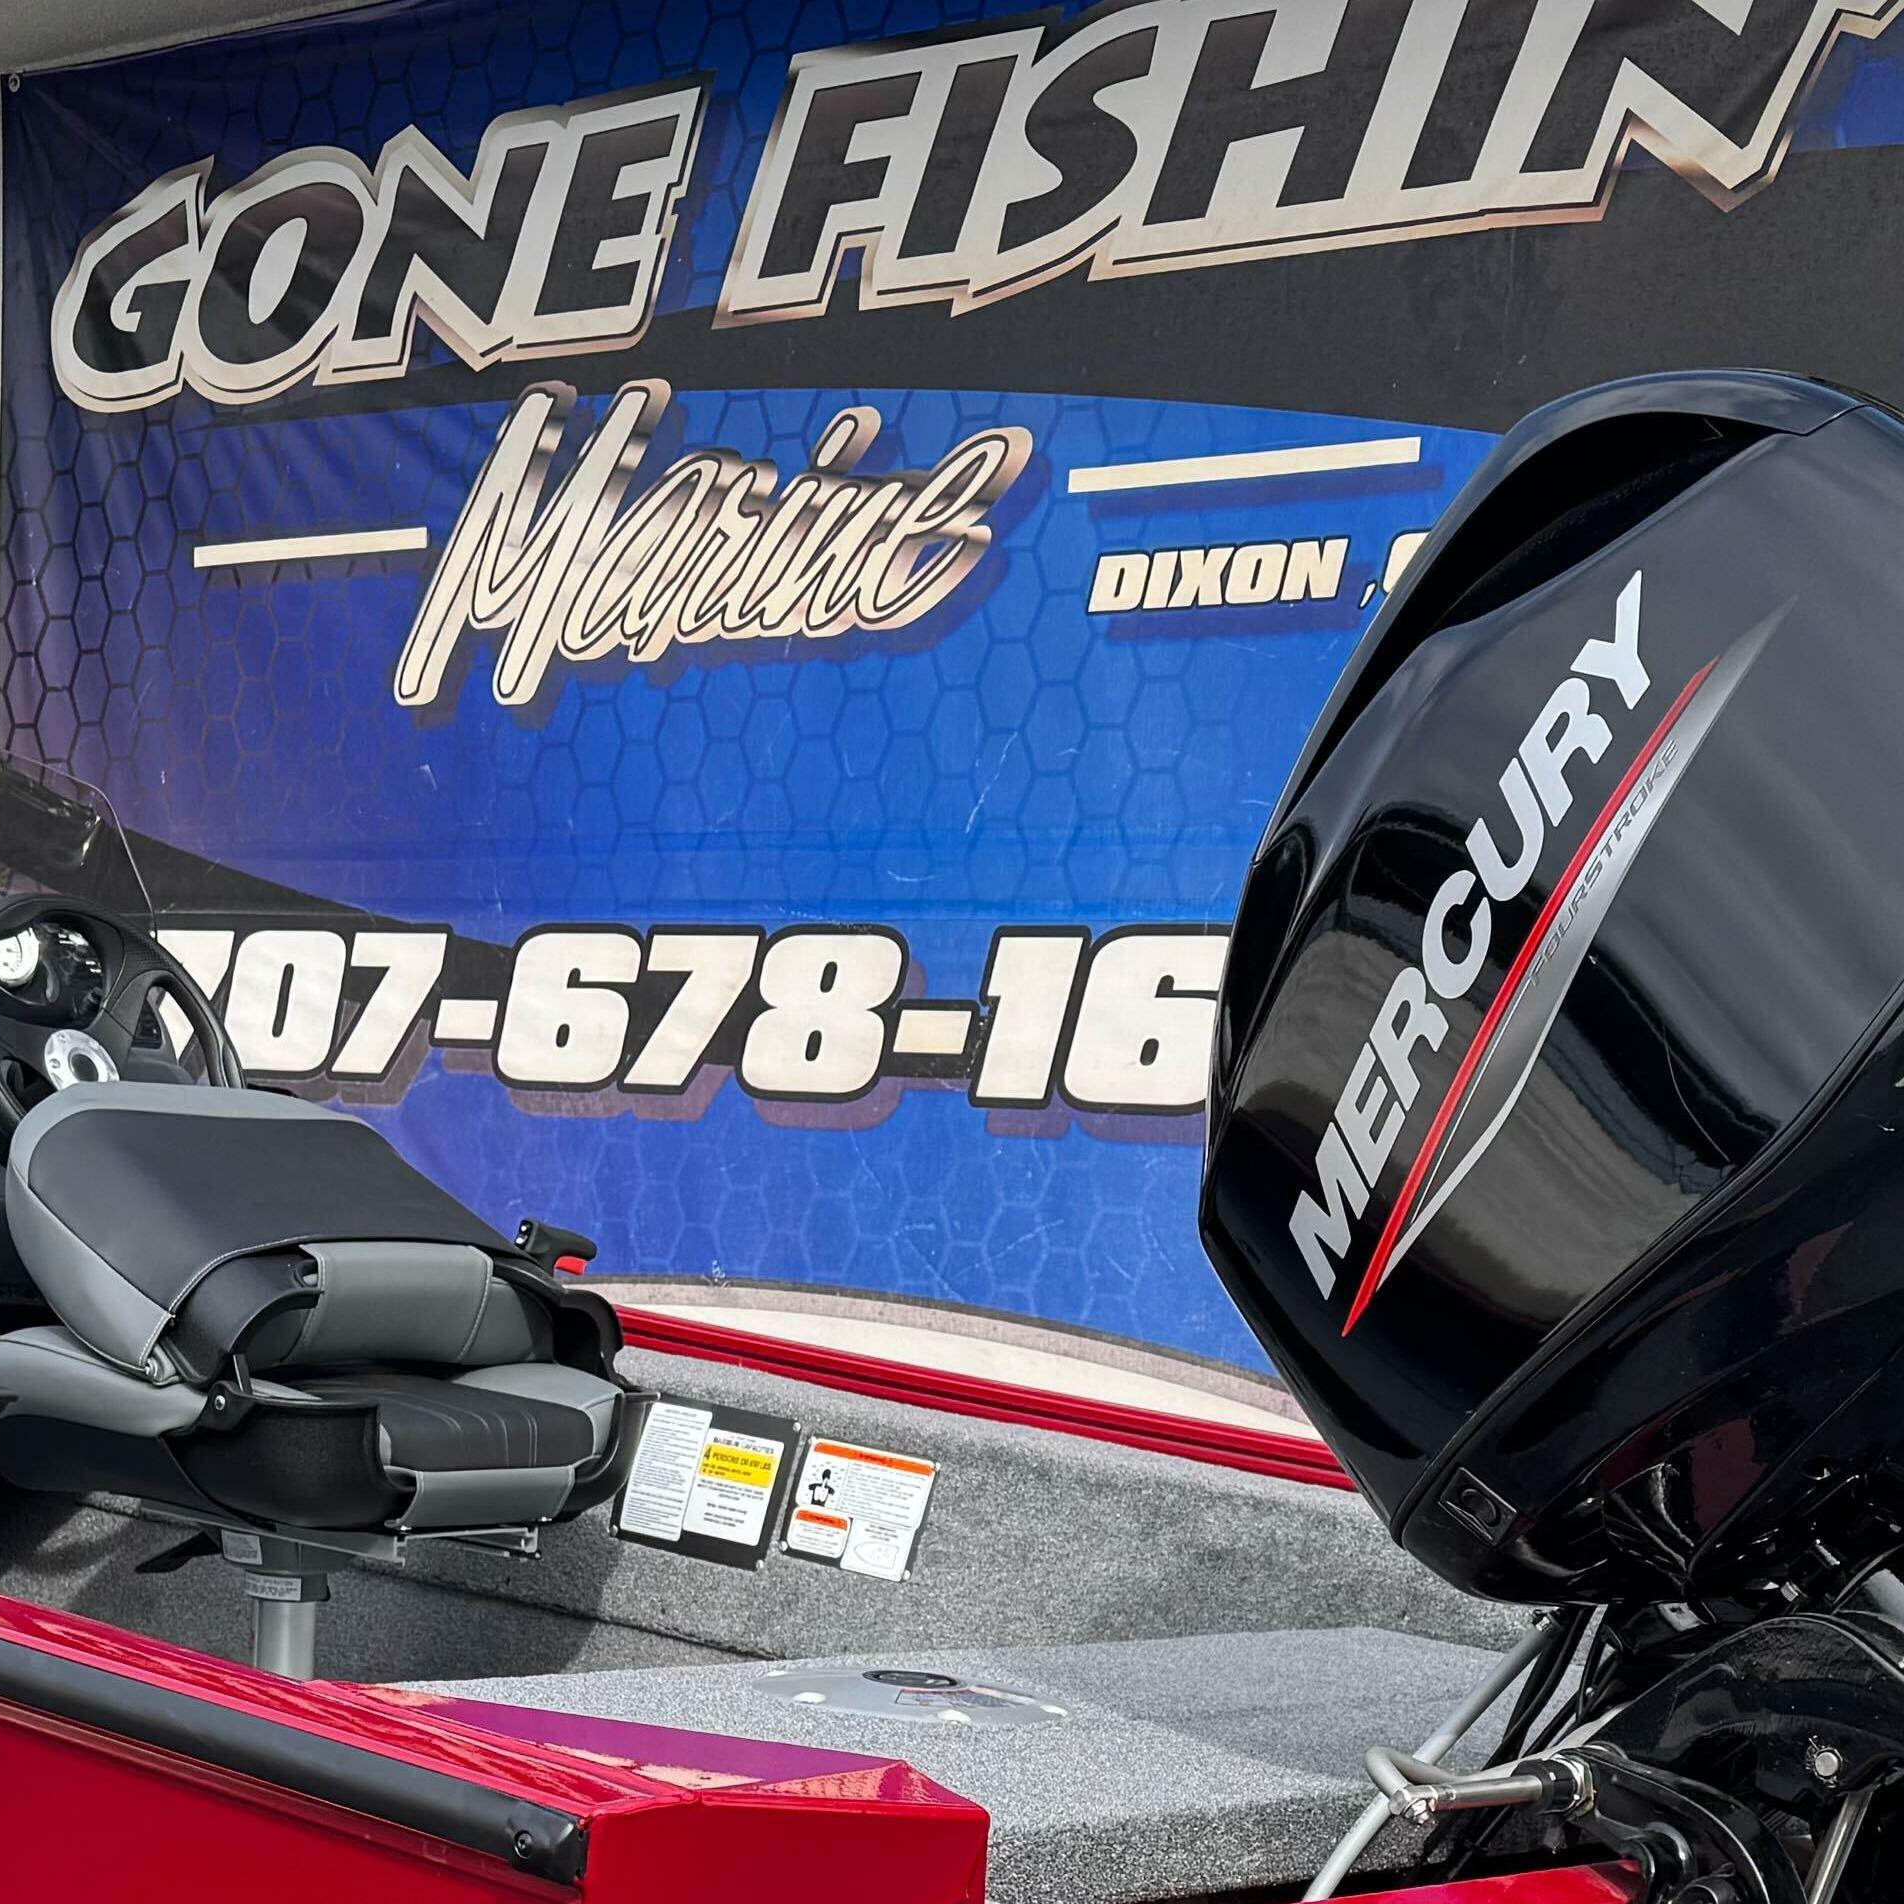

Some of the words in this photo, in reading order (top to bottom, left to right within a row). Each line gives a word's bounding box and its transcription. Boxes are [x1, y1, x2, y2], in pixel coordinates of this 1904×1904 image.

[51, 85, 708, 414] GONE
[392, 378, 1034, 706] Marine
[1287, 568, 1653, 1303] MERCURY
[1529, 737, 1680, 988] FOURSTROKE
